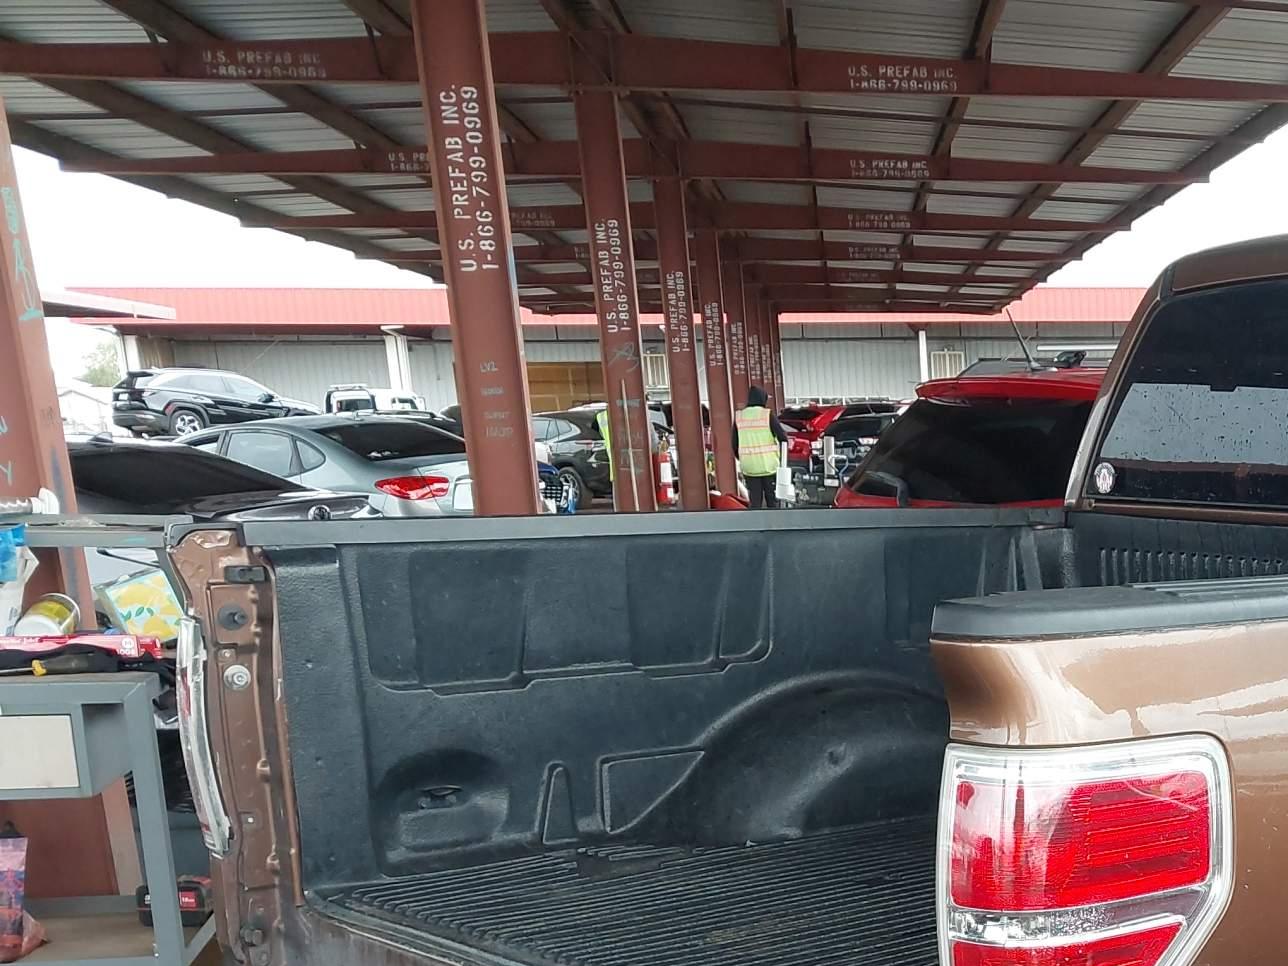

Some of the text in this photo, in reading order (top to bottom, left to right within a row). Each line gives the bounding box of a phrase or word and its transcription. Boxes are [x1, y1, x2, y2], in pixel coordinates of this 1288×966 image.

[202, 50, 230, 63] U.S.
[847, 65, 873, 77] U.S.
[879, 65, 928, 78] PREFAB
[439, 84, 479, 273] U.S. PREFAB INC.
[460, 86, 500, 270] 1-866-799-0969
[594, 218, 619, 333] U.S. PREFAB INC.
[607, 219, 632, 331] 1-866-799-0969
